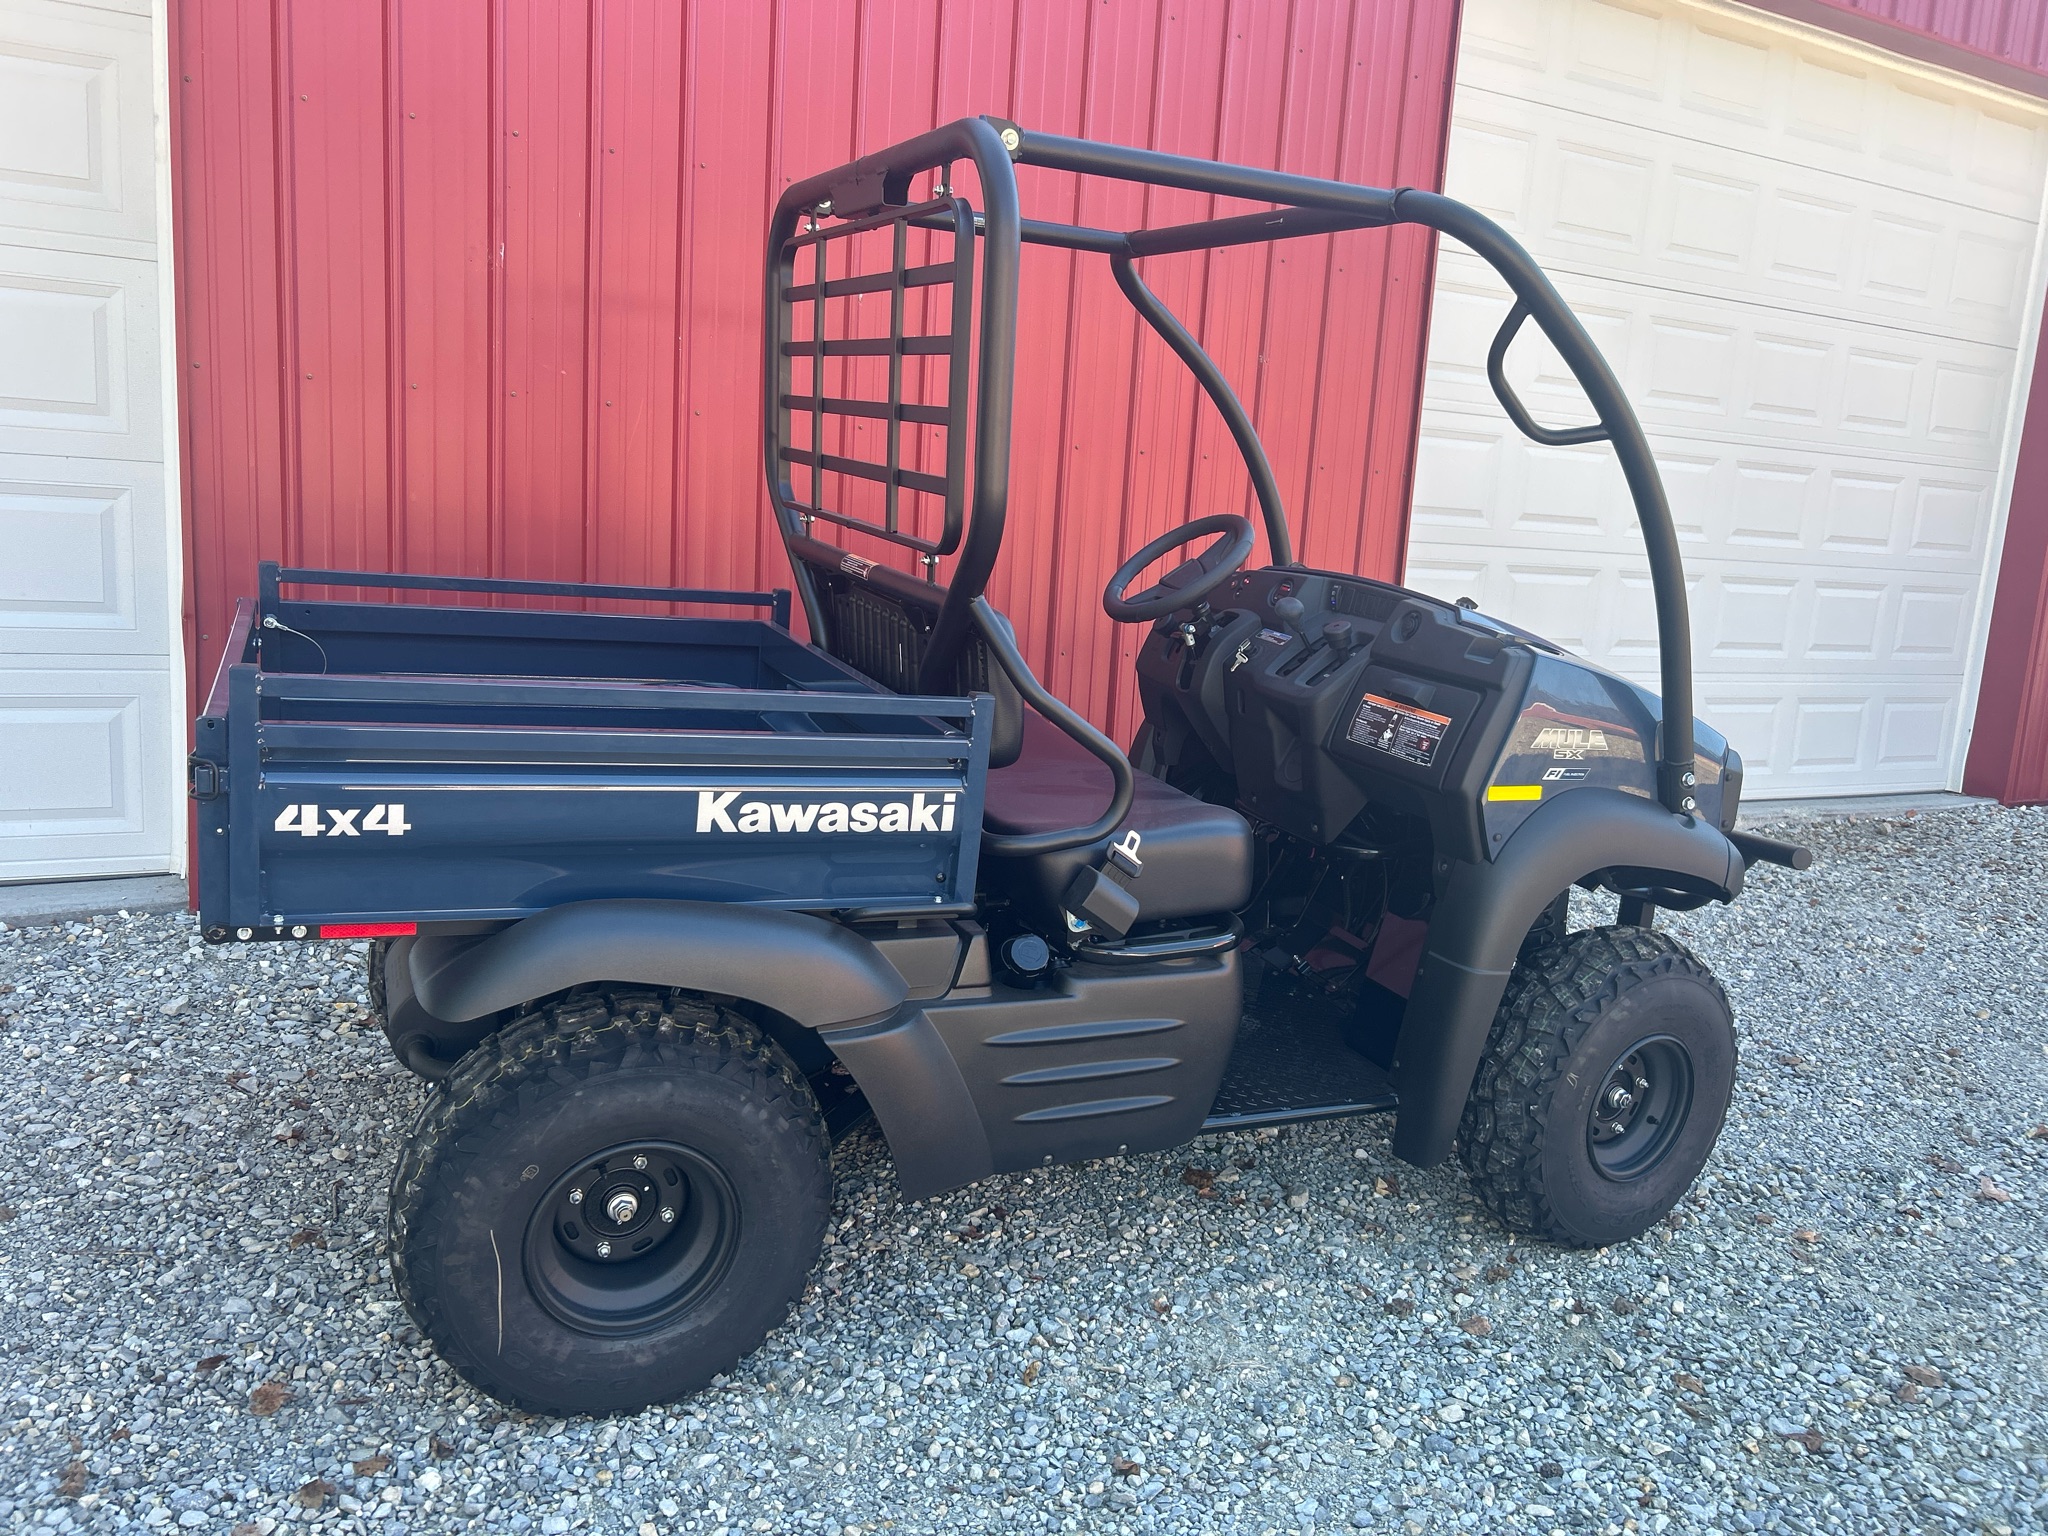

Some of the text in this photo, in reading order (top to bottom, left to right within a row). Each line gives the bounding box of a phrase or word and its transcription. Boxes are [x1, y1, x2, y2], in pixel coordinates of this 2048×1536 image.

[1530, 728, 1609, 750] MULE
[1553, 749, 1585, 760] SX
[1546, 769, 1562, 778] FI
[274, 803, 411, 836] 4x4
[697, 792, 956, 833] Kawasaki
